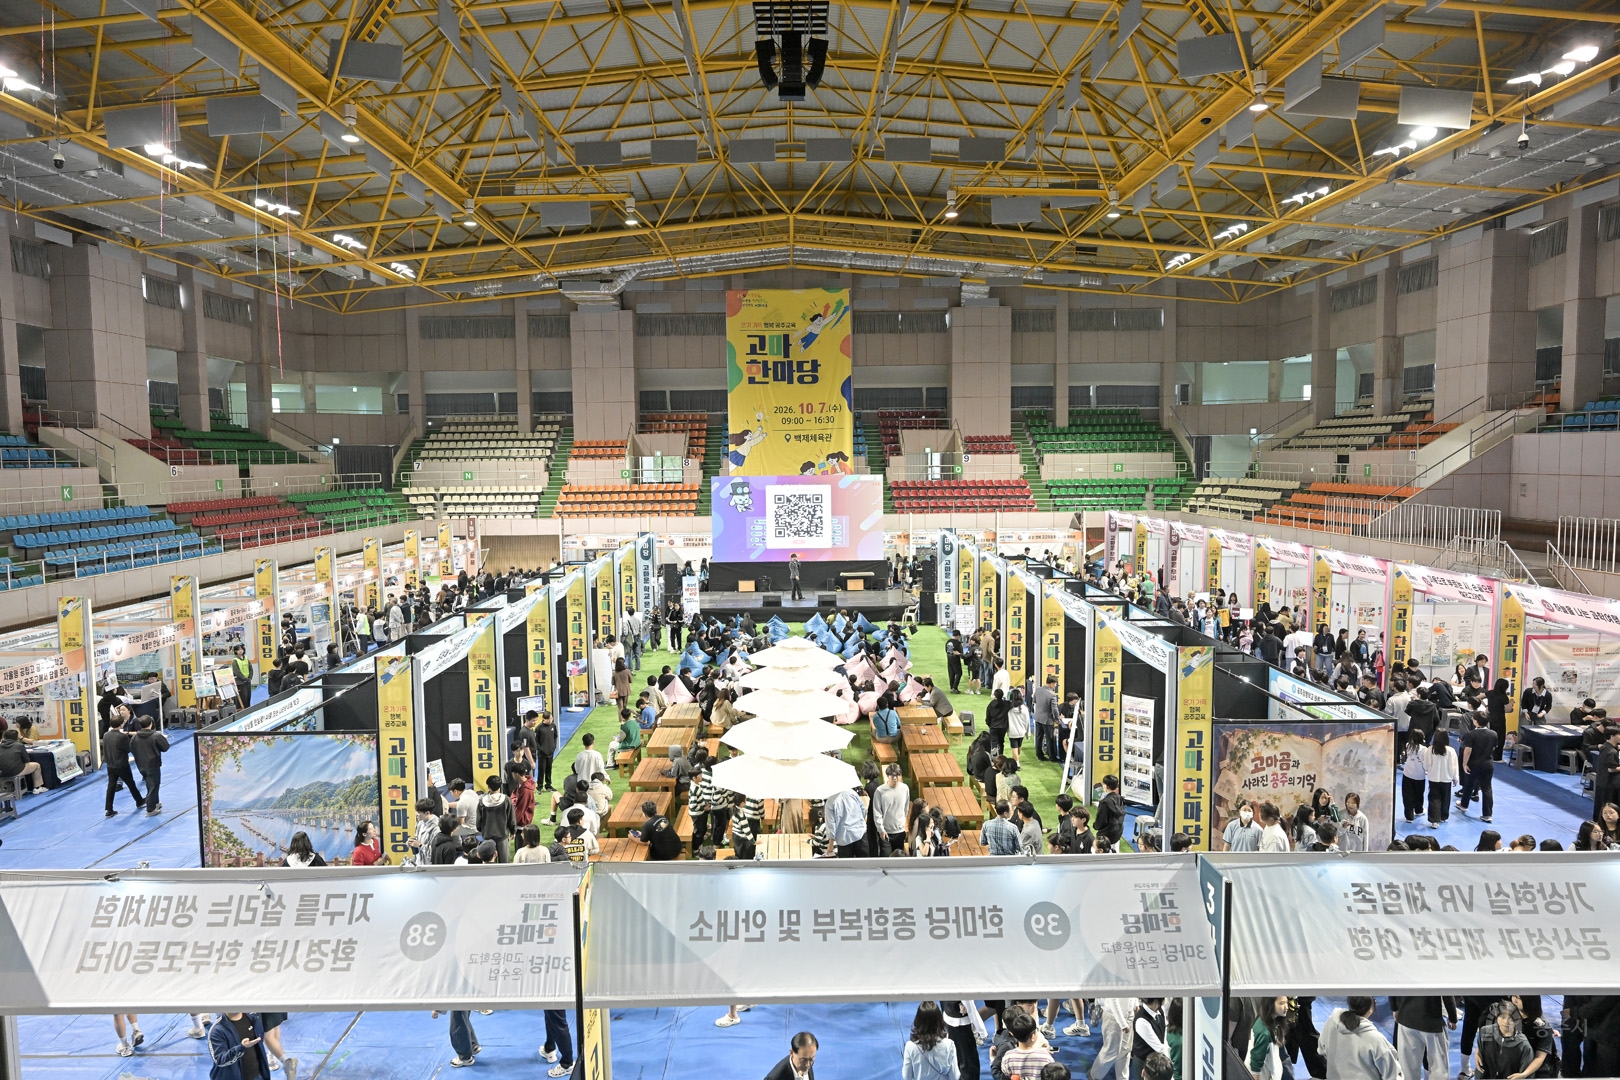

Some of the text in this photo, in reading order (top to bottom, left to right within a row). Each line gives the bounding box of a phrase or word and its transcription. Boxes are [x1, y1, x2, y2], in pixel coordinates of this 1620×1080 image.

[746, 334, 792, 359] 고마
[746, 359, 822, 385] 한마당
[774, 406, 796, 414] 2026.
[799, 403, 816, 415] 10.
[781, 417, 804, 425] 09:00
[814, 416, 835, 424] 16:30
[794, 434, 832, 443] 백제체육관
[172, 466, 177, 475] 6
[684, 459, 690, 467] 8
[63, 488, 70, 498] K
[602, 592, 611, 612] 고마
[983, 588, 994, 632] 고마 한마
[262, 624, 273, 658] 한마당
[572, 612, 584, 659] 고마 한마
[1011, 607, 1023, 671] 고마 한마당
[1047, 634, 1060, 660] 고마
[1395, 609, 1407, 661] 고마 한마
[533, 639, 546, 666] 고마
[1504, 635, 1518, 662] 고마
[20, 667, 35, 677] 공립고
[24, 673, 48, 688] 공주고에서
[181, 664, 194, 691] 마당
[69, 696, 85, 733] 마당
[384, 705, 396, 713] 온기
[1099, 671, 1116, 762] 고마 한마당
[476, 678, 494, 769] 고마 한마당
[1250, 752, 1300, 774] 고마곰과
[1183, 730, 1204, 845] 고마 한마당
[1242, 772, 1317, 793] 사라진 공주의 기억
[388, 738, 410, 854] 고마 한마당
